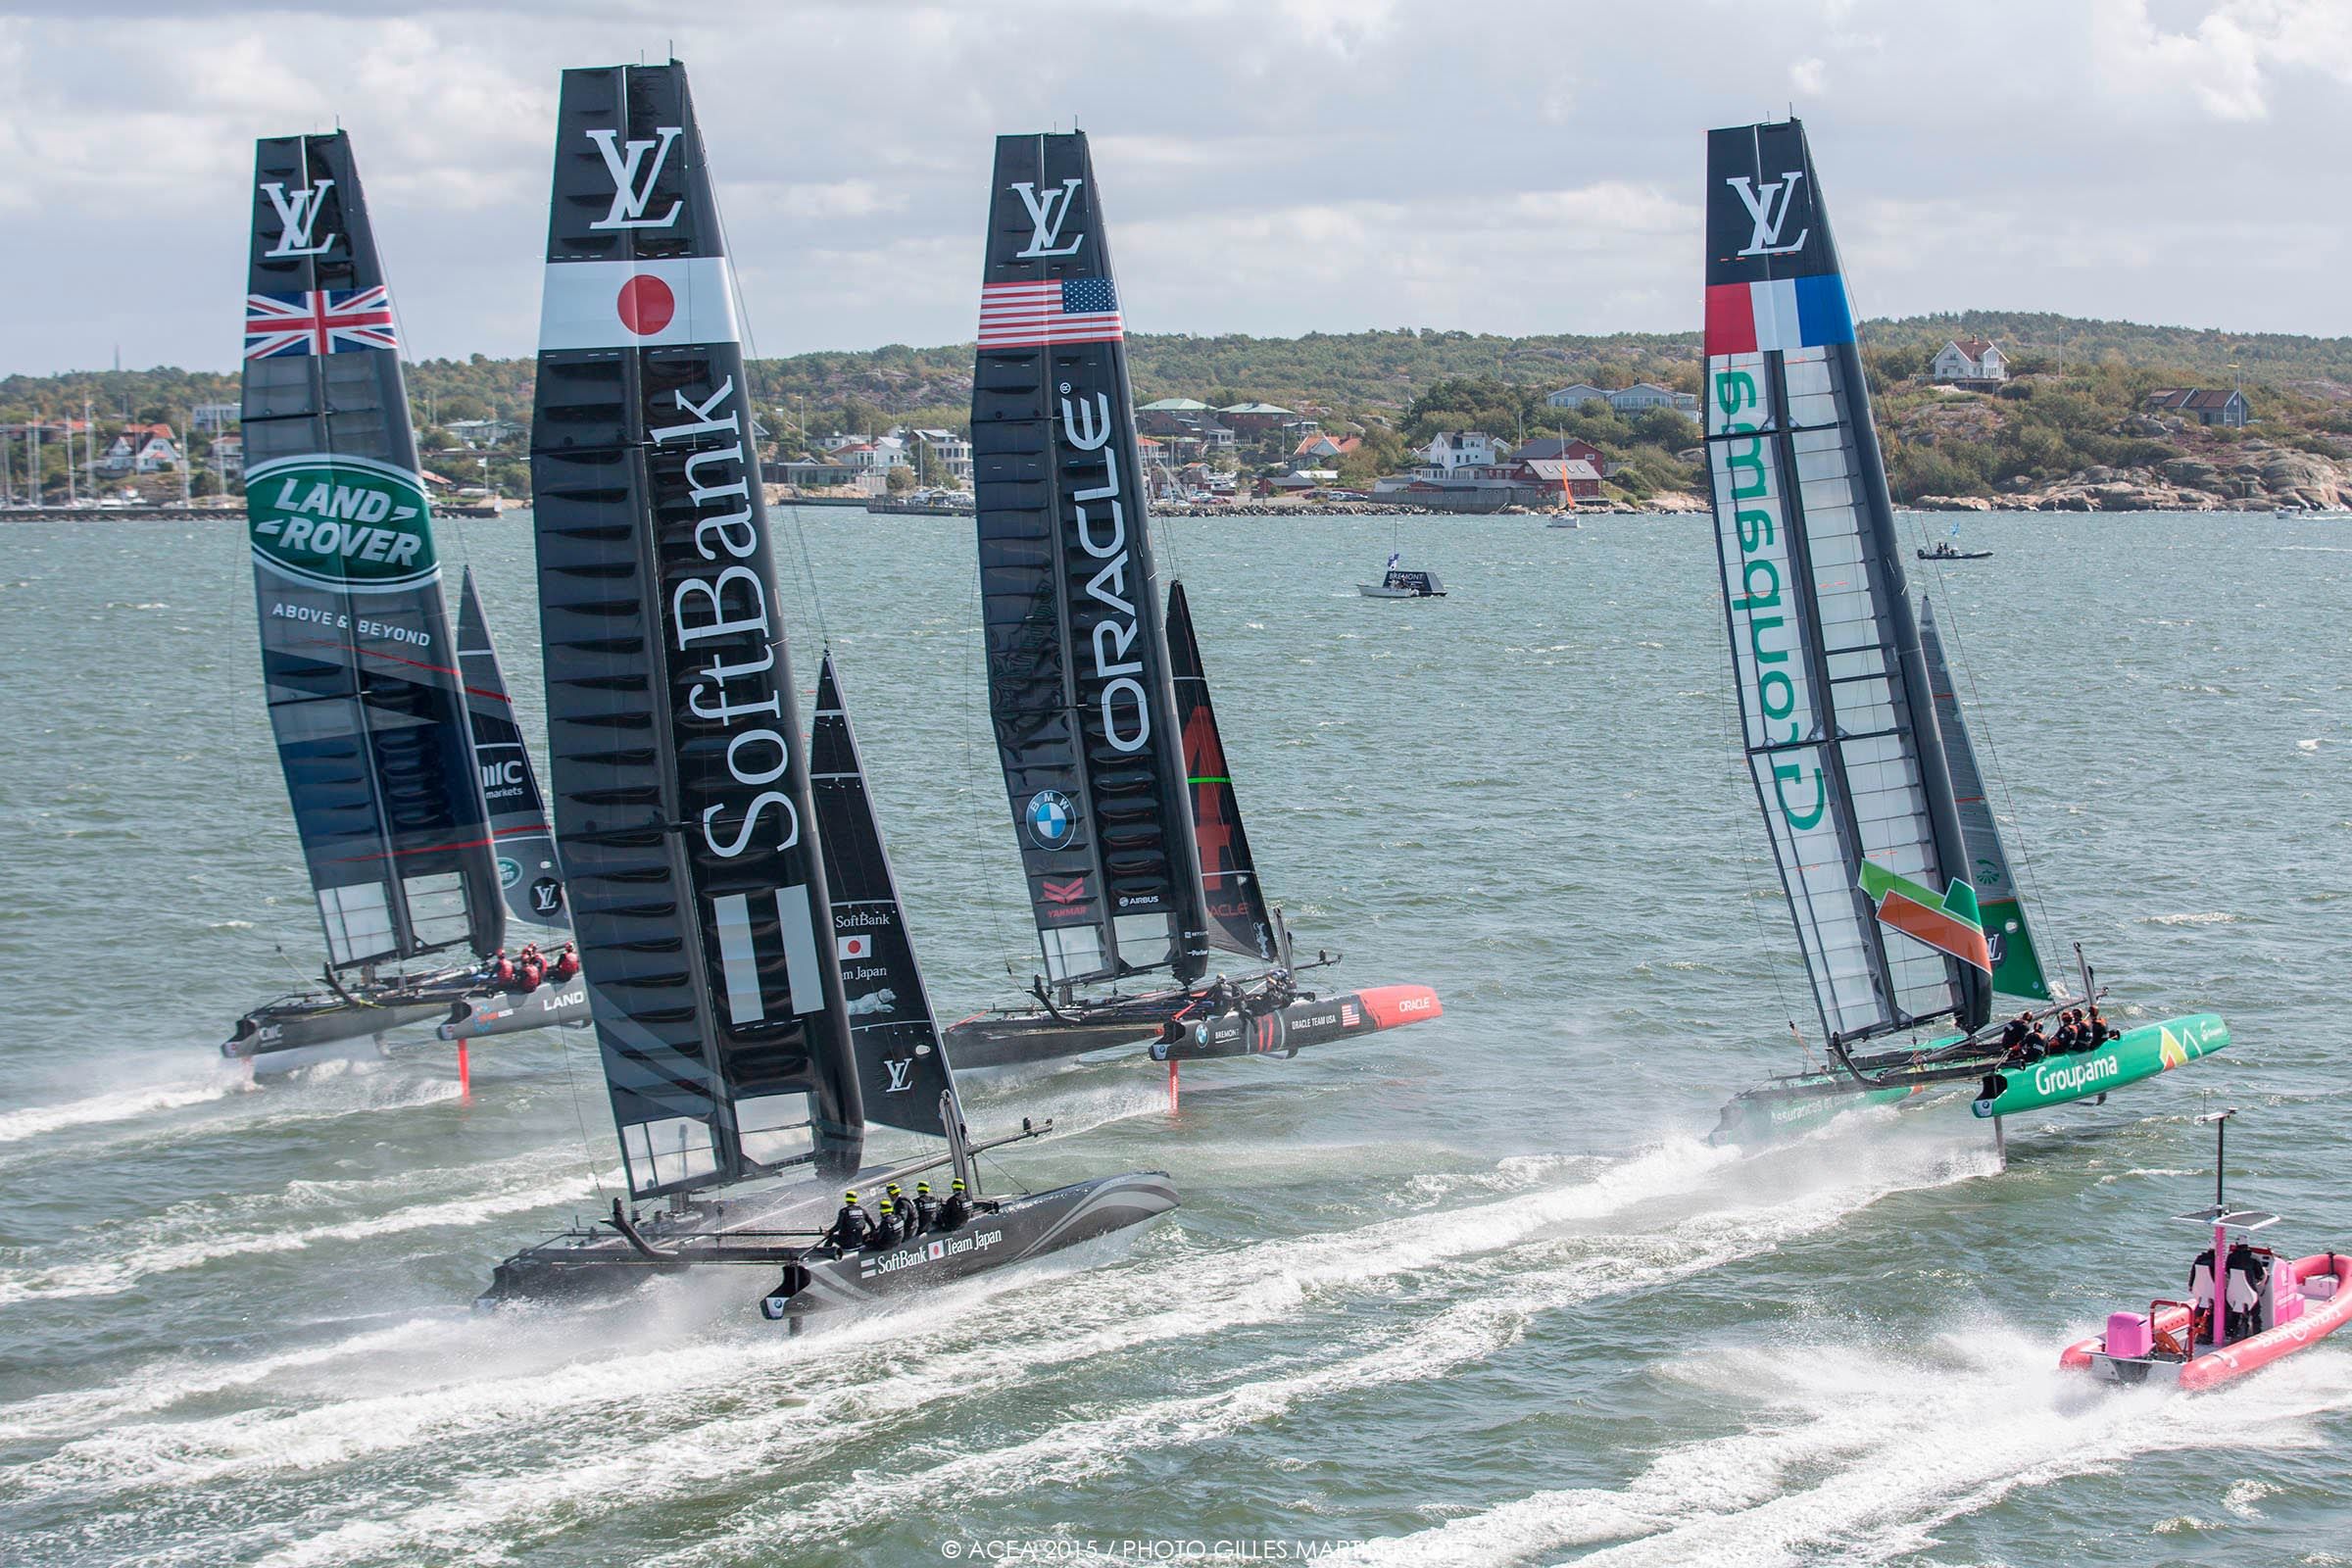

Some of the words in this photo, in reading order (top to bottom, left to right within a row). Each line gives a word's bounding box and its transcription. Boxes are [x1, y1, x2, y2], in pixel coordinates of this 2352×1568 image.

[273, 477, 392, 523] LAND
[278, 518, 422, 566] ROVER
[272, 603, 333, 625] ABOVE
[336, 614, 348, 629] &
[358, 619, 430, 647] BEYOND
[649, 374, 799, 858] SoftBank
[486, 787, 523, 800] markets
[1030, 792, 1069, 812] BMW
[1130, 895, 1159, 905] AIRBUS
[835, 913, 891, 928] SoftBank
[855, 966, 888, 981] Japan
[543, 991, 585, 1011] LAND
[1398, 997, 1431, 1012] ORACLE
[1292, 1017, 1311, 1030] ORACLE
[1311, 1015, 1326, 1028] TEAM
[1326, 1014, 1337, 1025] USA
[2035, 1054, 2118, 1096] Groupama
[878, 1247, 927, 1275] SoftBank
[945, 1237, 973, 1257] Team
[973, 1230, 1003, 1252] Japan
